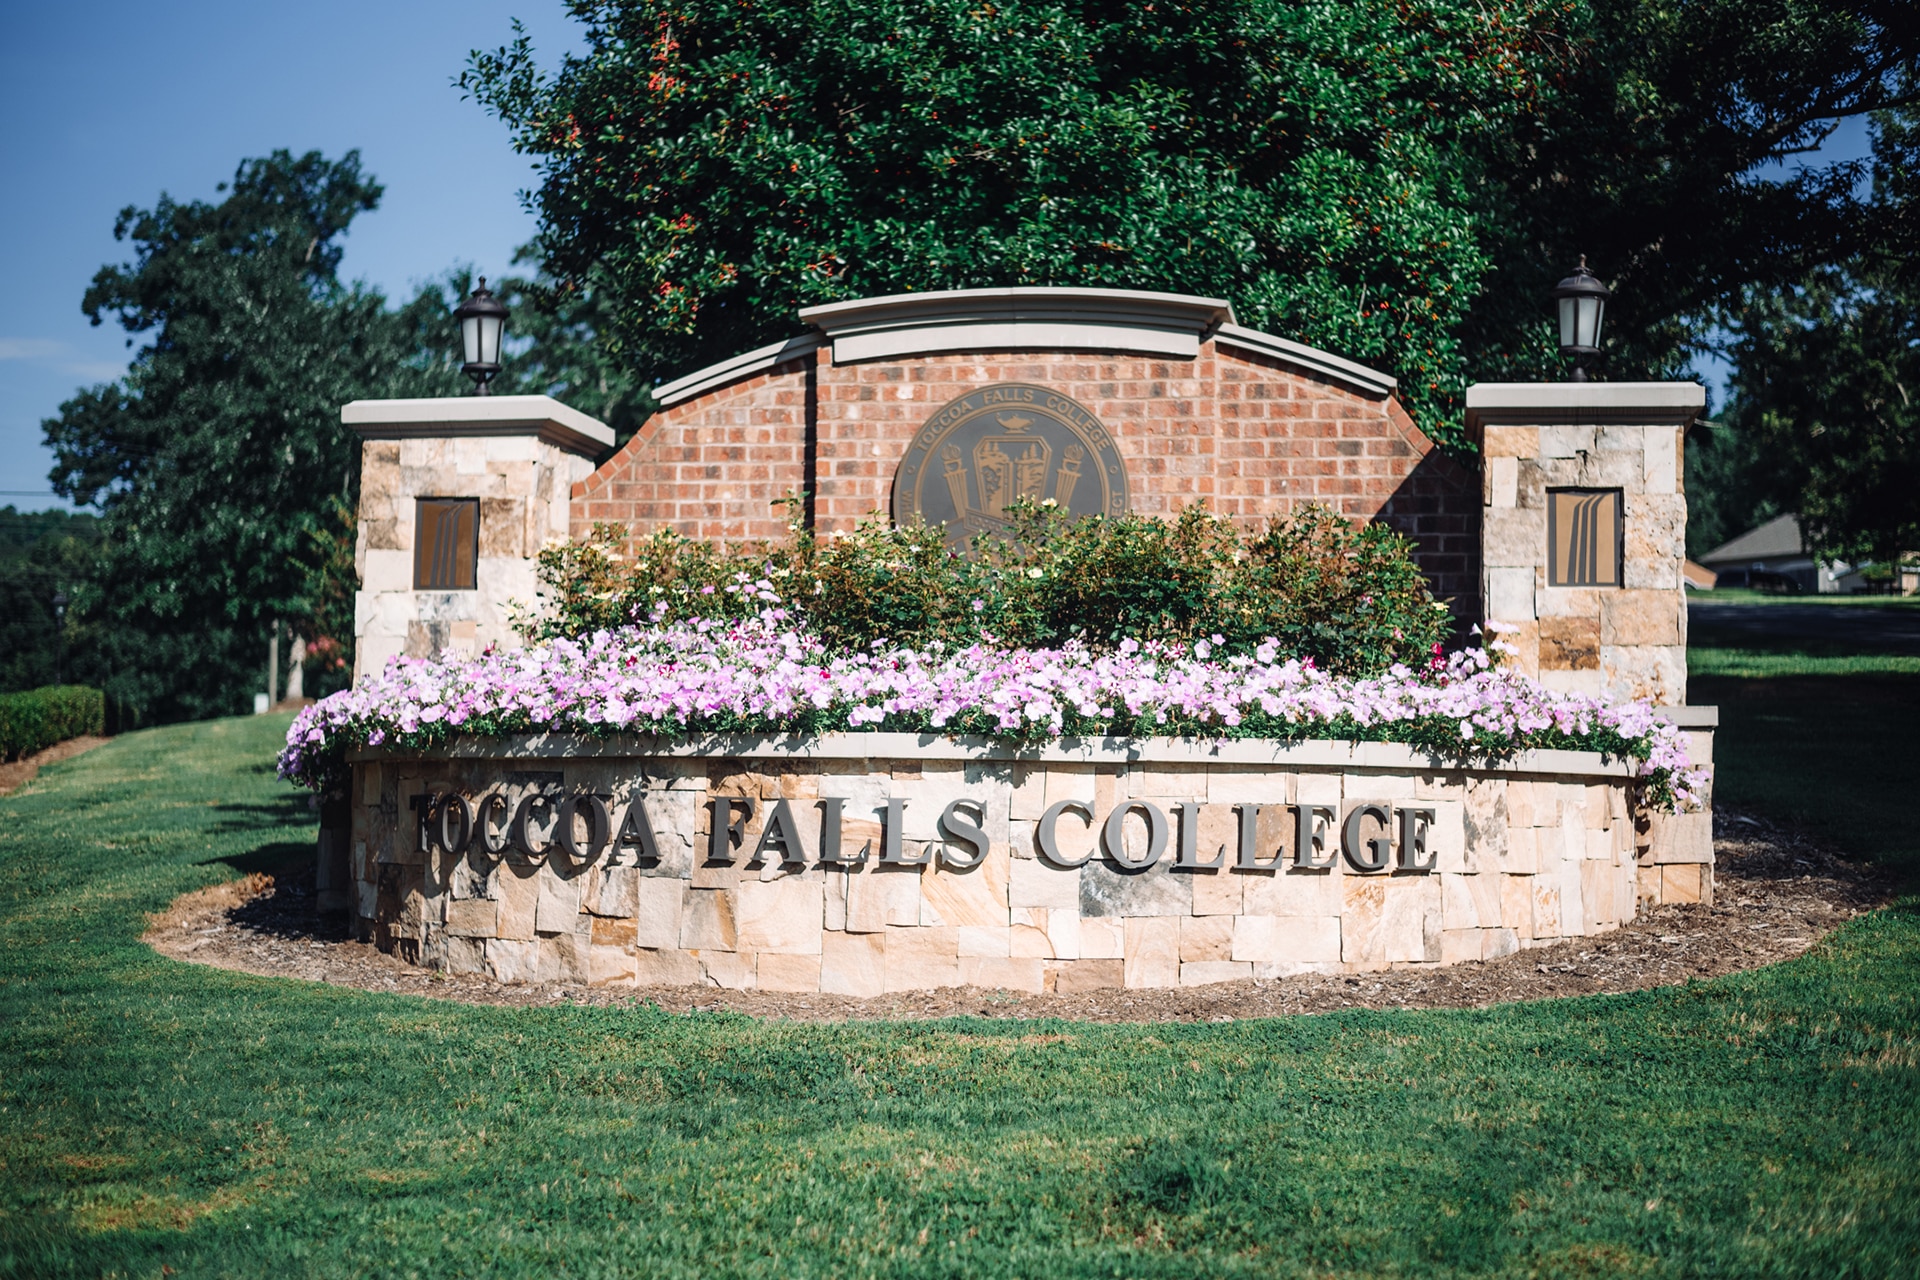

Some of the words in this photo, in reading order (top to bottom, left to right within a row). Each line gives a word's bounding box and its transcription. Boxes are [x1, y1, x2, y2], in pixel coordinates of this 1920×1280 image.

[917, 401, 973, 452] TOCCOA
[983, 389, 1034, 404] FALLS
[1046, 397, 1110, 451] COLLEGE
[410, 792, 663, 859] TOCCOA
[708, 796, 988, 869] FALLS
[1037, 800, 1437, 871] COLLEGE
